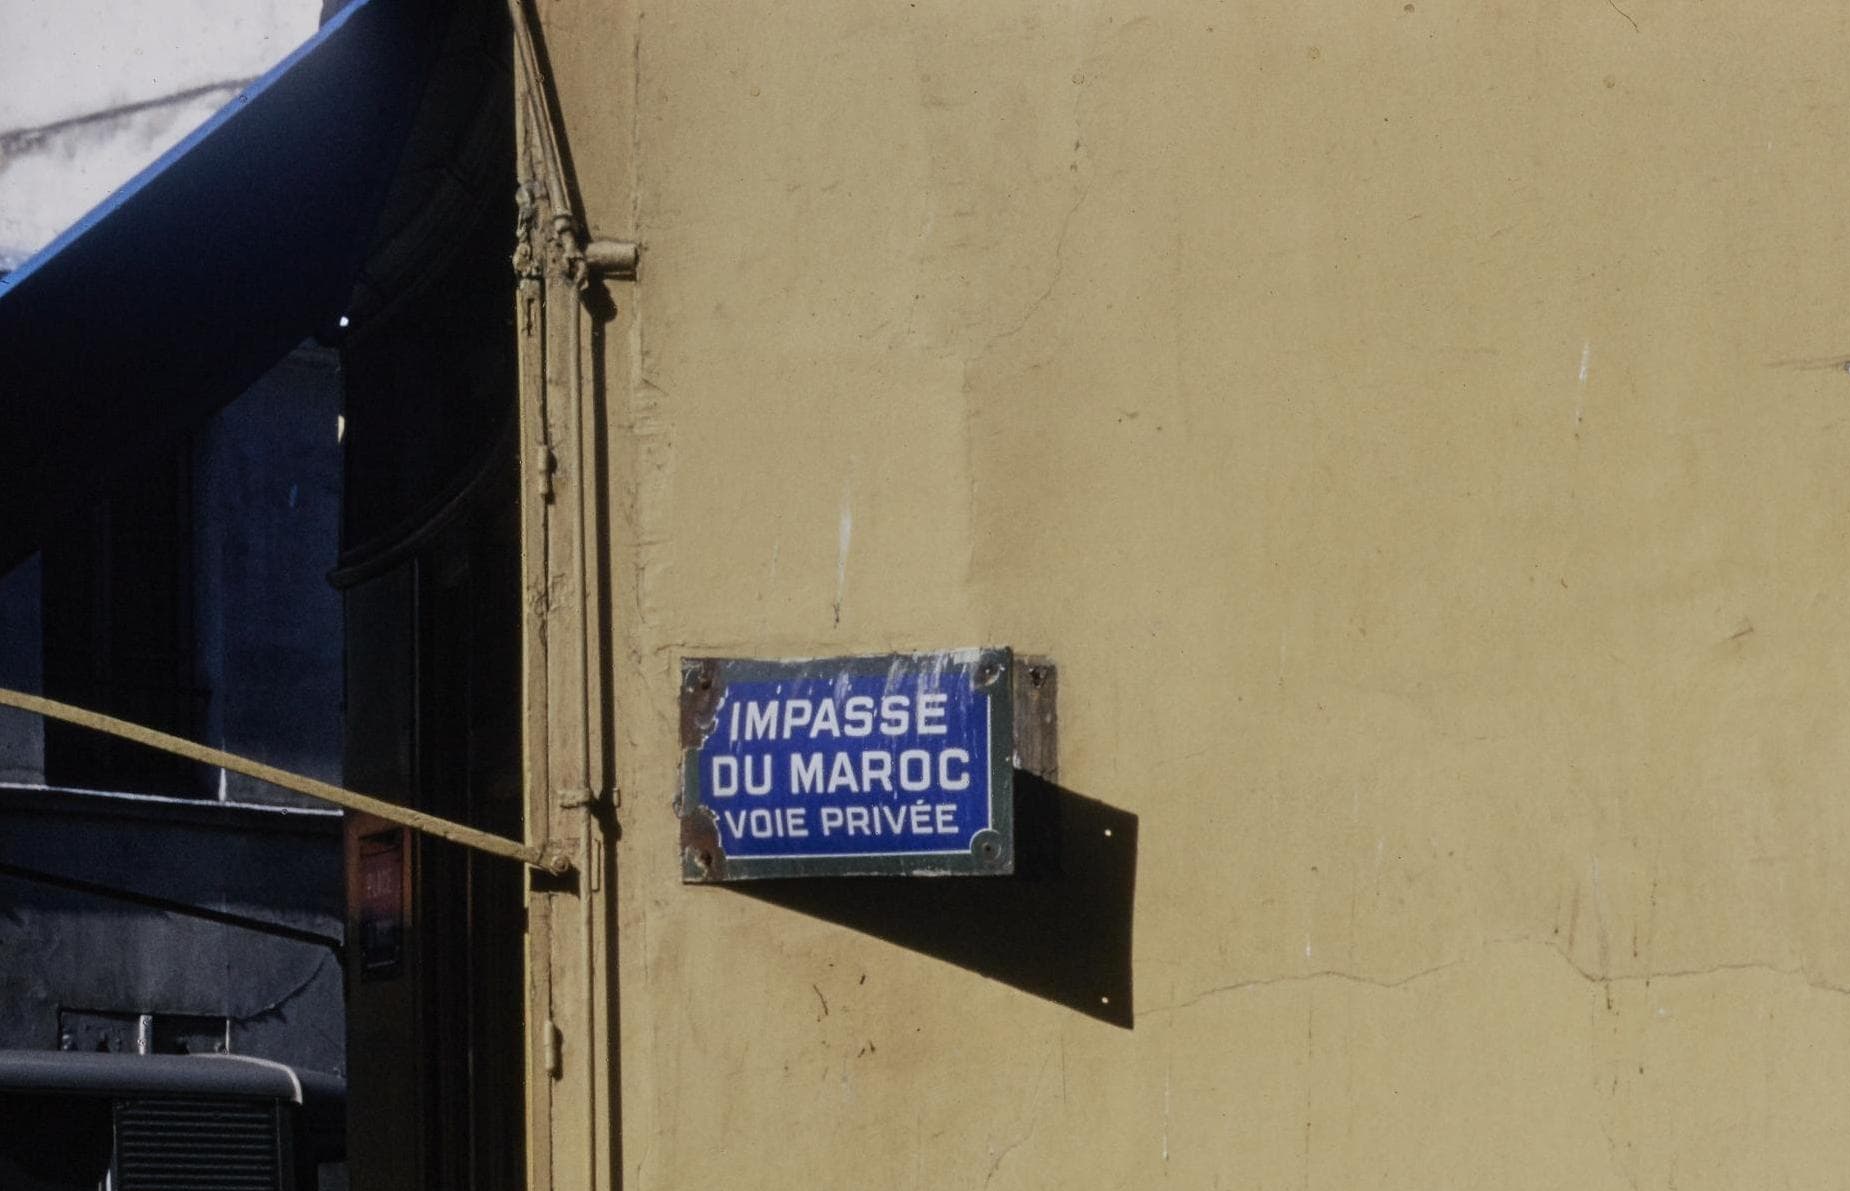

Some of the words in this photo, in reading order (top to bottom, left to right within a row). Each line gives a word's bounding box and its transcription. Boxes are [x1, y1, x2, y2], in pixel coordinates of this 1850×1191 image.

[729, 693, 948, 741] IMPASSE
[712, 753, 773, 797] DU
[790, 748, 970, 795] MAROC
[724, 806, 809, 839] VOIE
[821, 799, 960, 837] PRIVÉE
